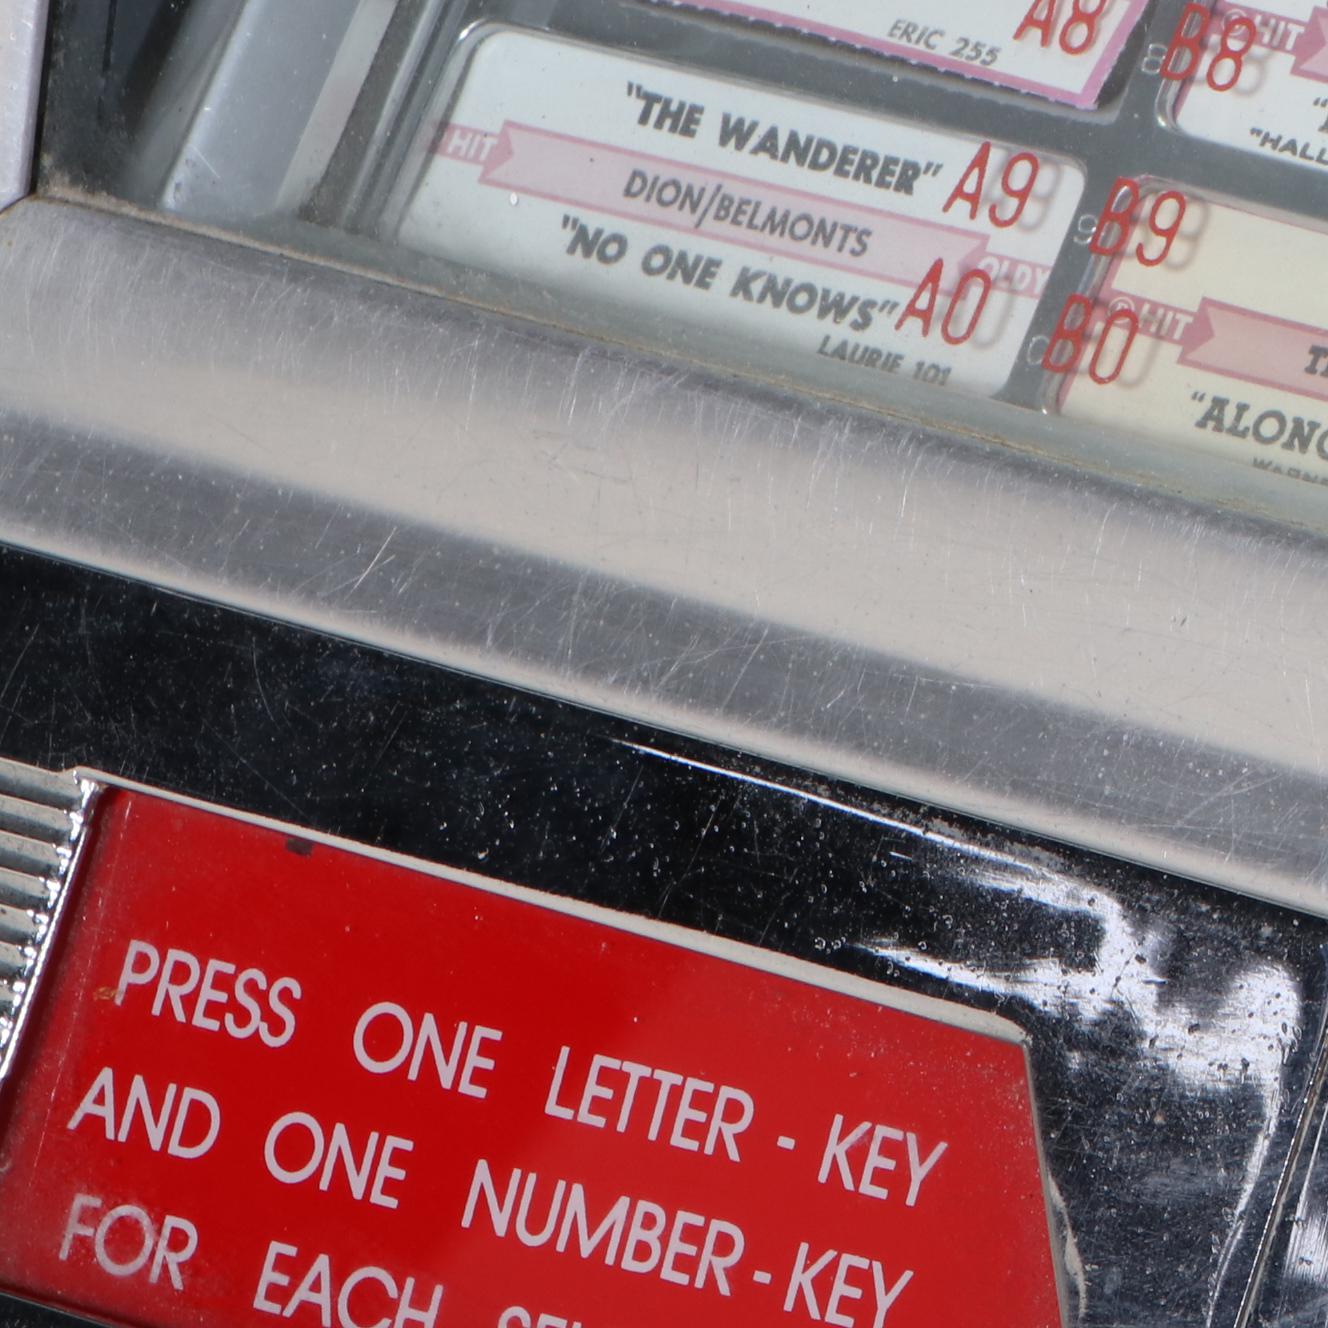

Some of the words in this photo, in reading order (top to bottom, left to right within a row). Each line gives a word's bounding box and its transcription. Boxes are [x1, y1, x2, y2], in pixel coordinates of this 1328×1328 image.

[627, 81, 704, 138] "THE
[718, 113, 943, 195] WANDERER"
[945, 143, 1039, 227] A9
[623, 169, 872, 257] DION/BELMONTS
[1089, 178, 1186, 266] B9
[562, 214, 628, 264] "NO
[641, 244, 722, 290] ONE
[729, 266, 899, 331] KNOWS"
[116, 940, 301, 1047] PRESS
[354, 1001, 502, 1098] ONE
[545, 1045, 754, 1162] LETTER
[817, 1113, 948, 1207] KEY
[68, 1067, 220, 1159] AND
[265, 1111, 413, 1209] ONE
[59, 1193, 198, 1290] FOR
[253, 1240, 444, 1328] EACH
